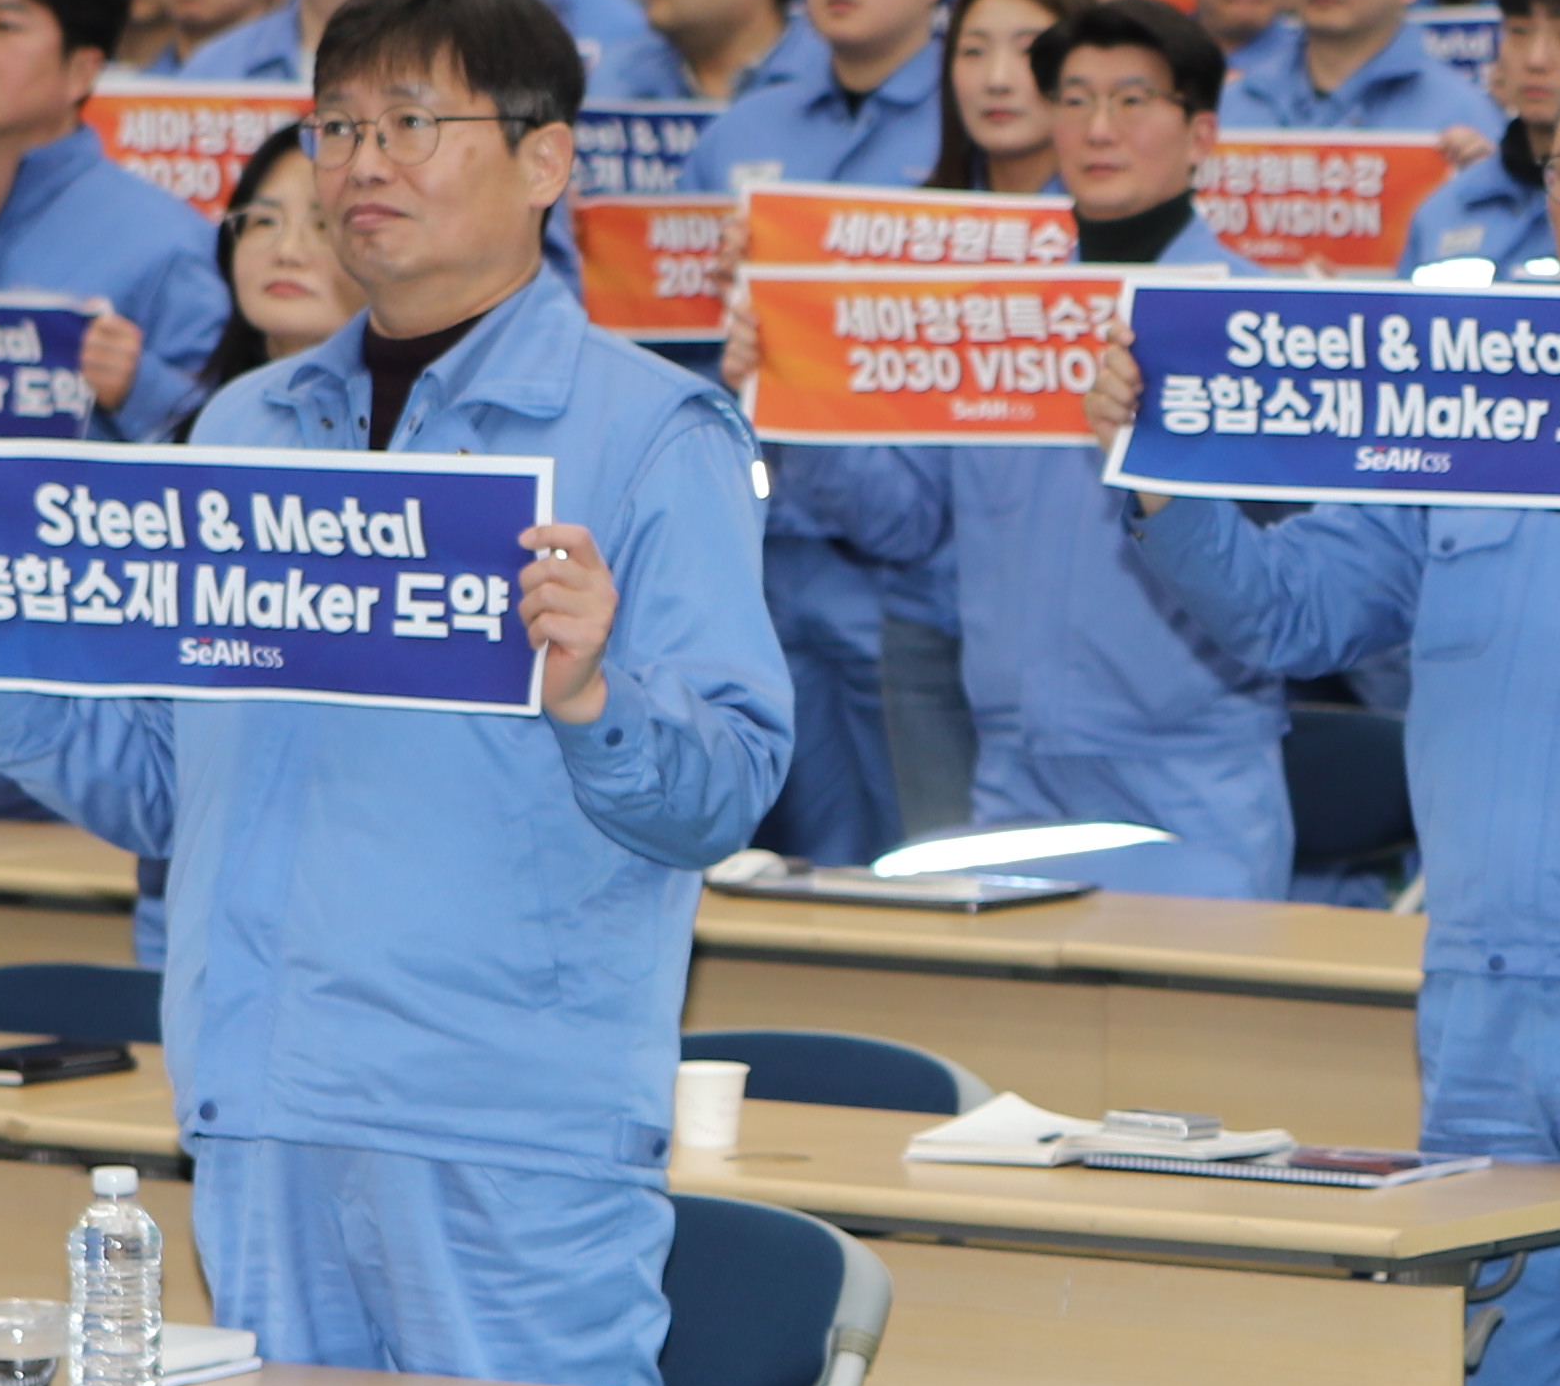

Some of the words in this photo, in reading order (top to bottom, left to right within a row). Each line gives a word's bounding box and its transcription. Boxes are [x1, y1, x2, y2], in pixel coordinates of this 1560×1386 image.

[822, 211, 1076, 263] 세아창원특수
[1252, 197, 1382, 237] VISION
[1226, 310, 1365, 370] Steel
[1378, 315, 1420, 374] &
[848, 347, 961, 393] 2030
[967, 348, 1102, 395] VISIO
[1161, 374, 1363, 439] 종합소재
[1375, 382, 1549, 441] Maker
[1356, 446, 1422, 473] SeAH
[34, 482, 185, 549] Steel
[197, 489, 244, 553] &
[251, 493, 427, 559] Metal
[193, 564, 379, 635] Maker
[392, 571, 509, 642] 도약
[179, 636, 250, 667] SeAH
